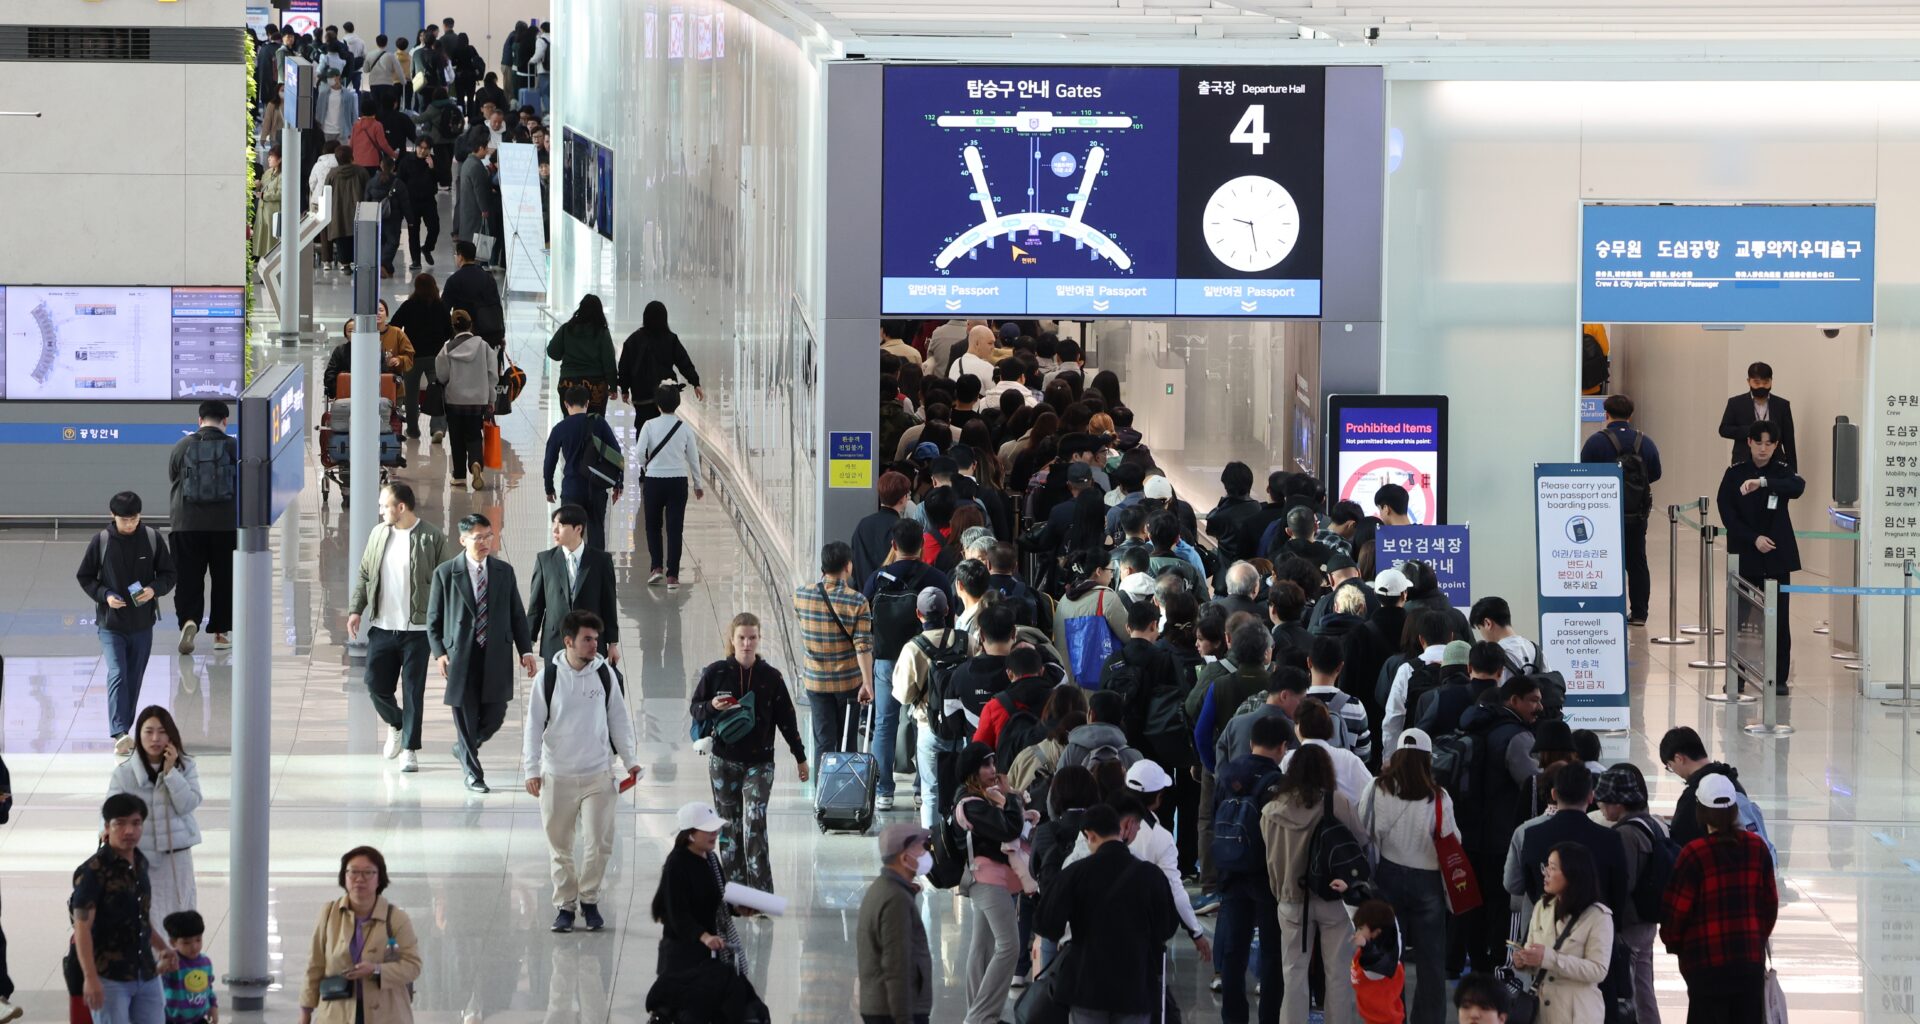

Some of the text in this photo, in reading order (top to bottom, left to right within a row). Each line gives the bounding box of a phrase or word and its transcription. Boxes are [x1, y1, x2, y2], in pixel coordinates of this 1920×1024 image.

[967, 80, 1102, 99] 탑승구 안내 Gates
[1198, 81, 1306, 96] 출국장 Departure Hall
[1229, 104, 1271, 156] 4
[1595, 239, 1642, 259] 승무원
[1657, 239, 1721, 259] 도심공항
[1595, 280, 1612, 288] Crew
[1620, 281, 1633, 289] City
[1635, 281, 1657, 289] Airport
[1687, 281, 1720, 289] Passenger
[907, 284, 1000, 298] 일반여권 Passport
[1055, 284, 1148, 298] 일반여권 Passport
[1203, 284, 1295, 298] 일반여권 Passport
[1887, 395, 1919, 407] 승무원
[1346, 423, 1432, 433] Prohibited Items
[1886, 425, 1918, 437] 도심공
[79, 428, 119, 439] 공항안내
[1357, 438, 1383, 446] permitted
[1384, 438, 1404, 446] beyond
[1416, 438, 1432, 446] point:
[1886, 456, 1918, 468] 보행상
[1541, 481, 1616, 491] Please carry your
[1560, 492, 1599, 501] passport
[1600, 491, 1618, 499] and
[1885, 486, 1917, 498] 고령자
[1547, 501, 1611, 510] boarding pass.
[1885, 516, 1917, 528] 임신부
[1885, 531, 1909, 539] Pregnant
[1382, 537, 1462, 554] 보안검색장
[1552, 549, 1608, 559] 여권/탑승권은
[1884, 547, 1916, 559] 출입국
[1567, 560, 1593, 570] 반드시
[1557, 570, 1603, 580] 본인이 소지
[1563, 581, 1598, 590] 해주세요
[1564, 618, 1601, 627] Farewell
[1557, 628, 1608, 637] passengers
[1583, 637, 1616, 645] allowed
[1566, 647, 1601, 655] to enter.
[1570, 659, 1600, 669] 환송객
[1574, 670, 1593, 679] 절대
[1566, 680, 1605, 690] 진입금지
[1573, 714, 1621, 724] Incheon Airport
